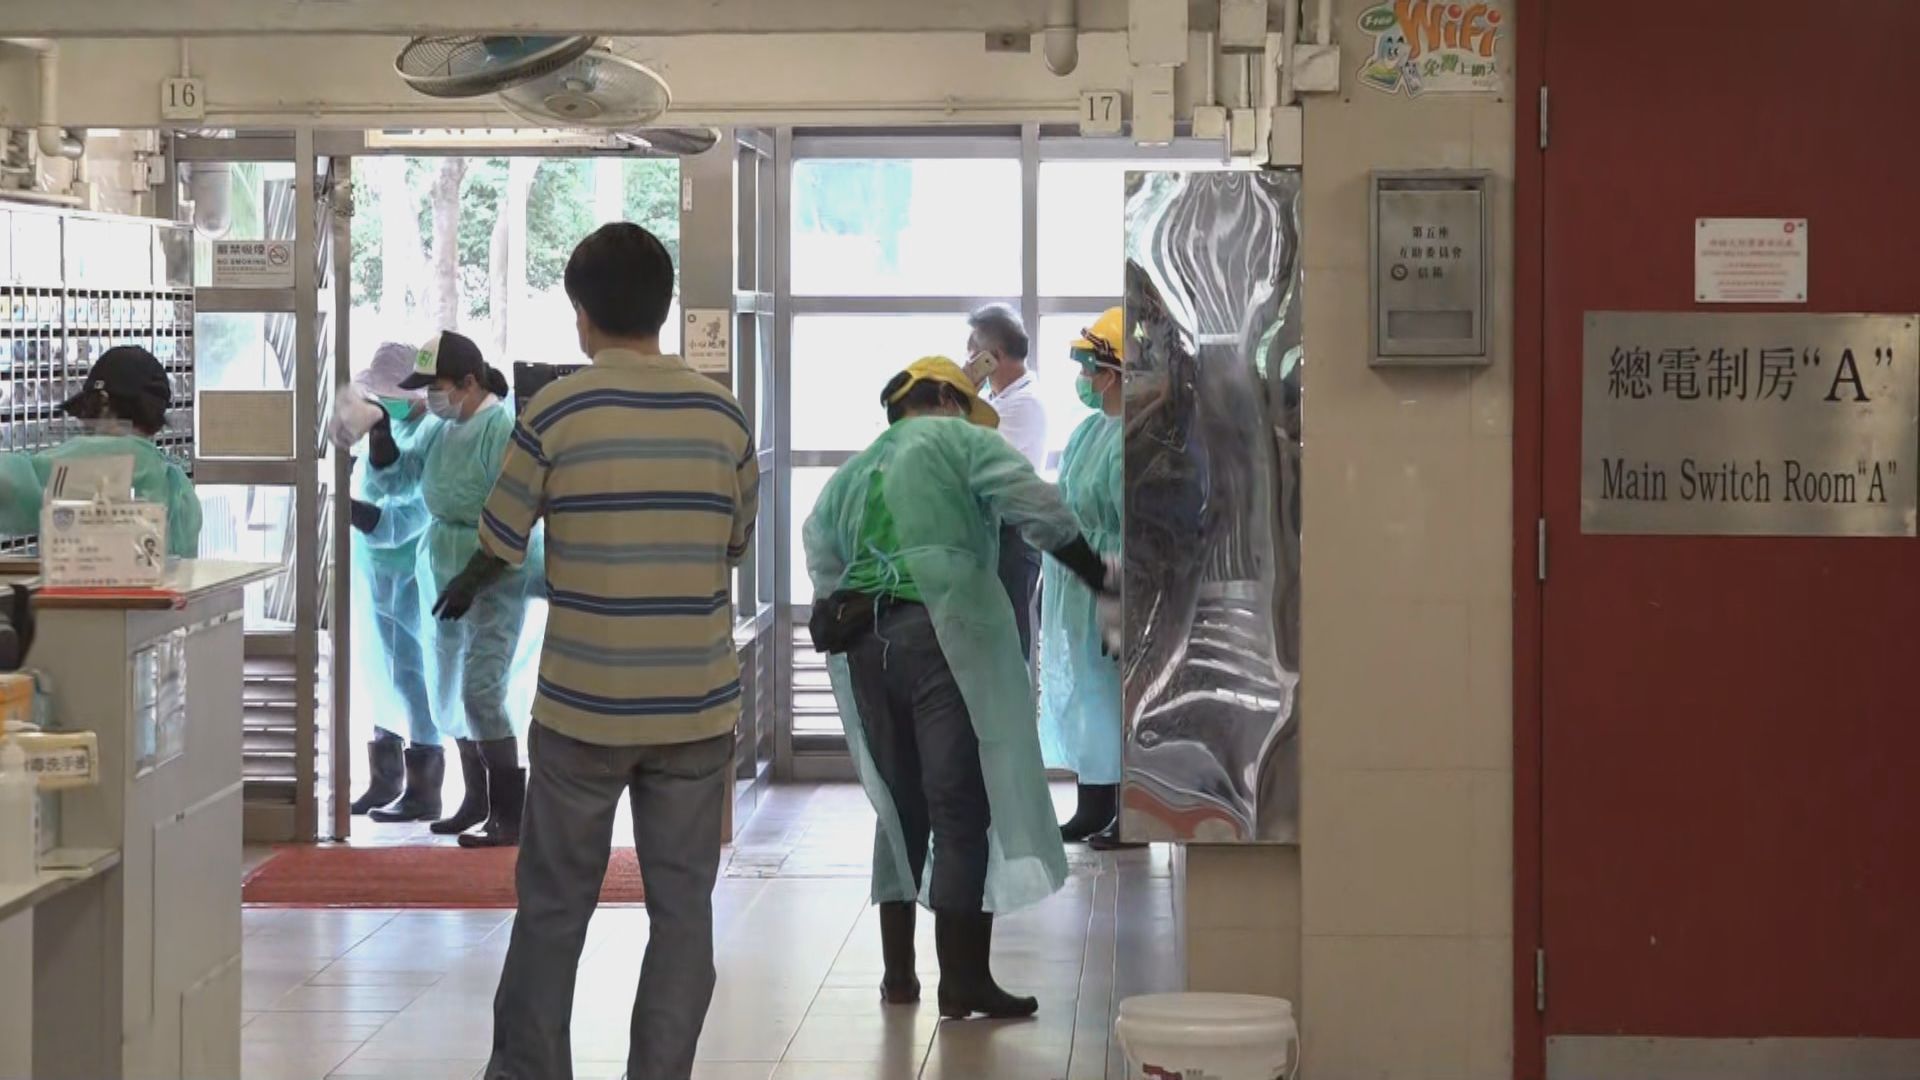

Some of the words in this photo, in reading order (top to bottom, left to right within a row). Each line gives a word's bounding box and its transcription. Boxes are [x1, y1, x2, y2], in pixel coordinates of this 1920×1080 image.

[1394, 0, 1501, 59] WiFi
[169, 82, 195, 107] 16
[1088, 96, 1113, 121] 17
[1601, 458, 1667, 501] Main
[1679, 459, 1770, 503] Switch
